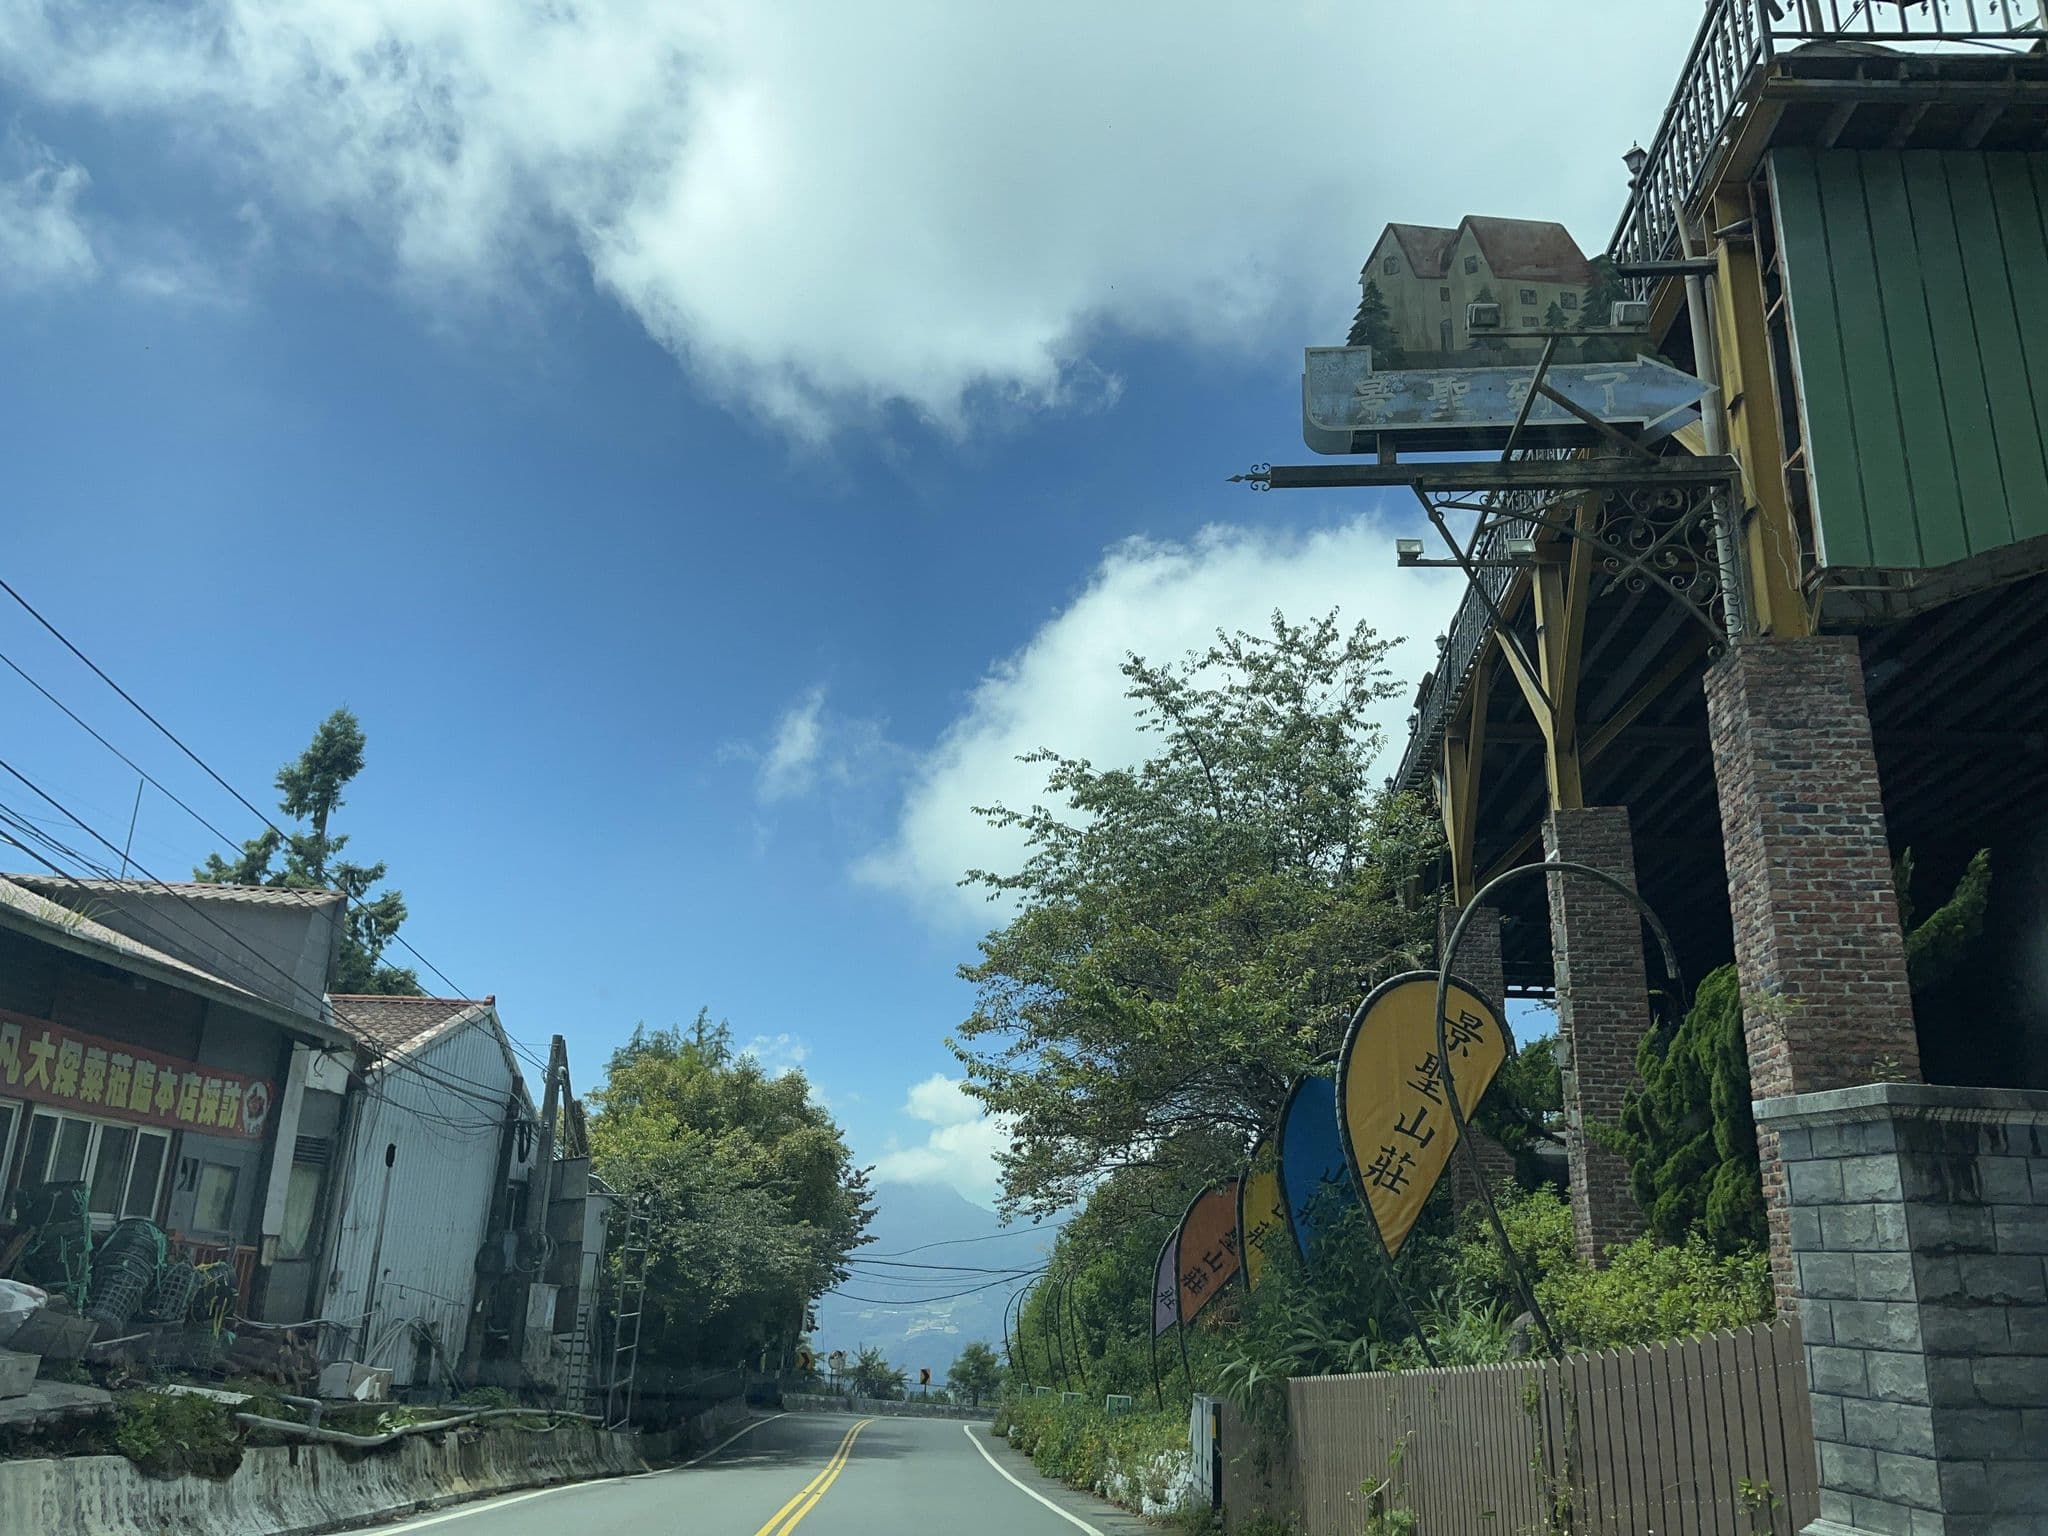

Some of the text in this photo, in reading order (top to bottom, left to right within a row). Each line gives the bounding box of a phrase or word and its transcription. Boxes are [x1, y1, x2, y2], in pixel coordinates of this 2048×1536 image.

[1352, 372, 1629, 422] 景聖到了
[1363, 1009, 1484, 1195] 景聖山莊
